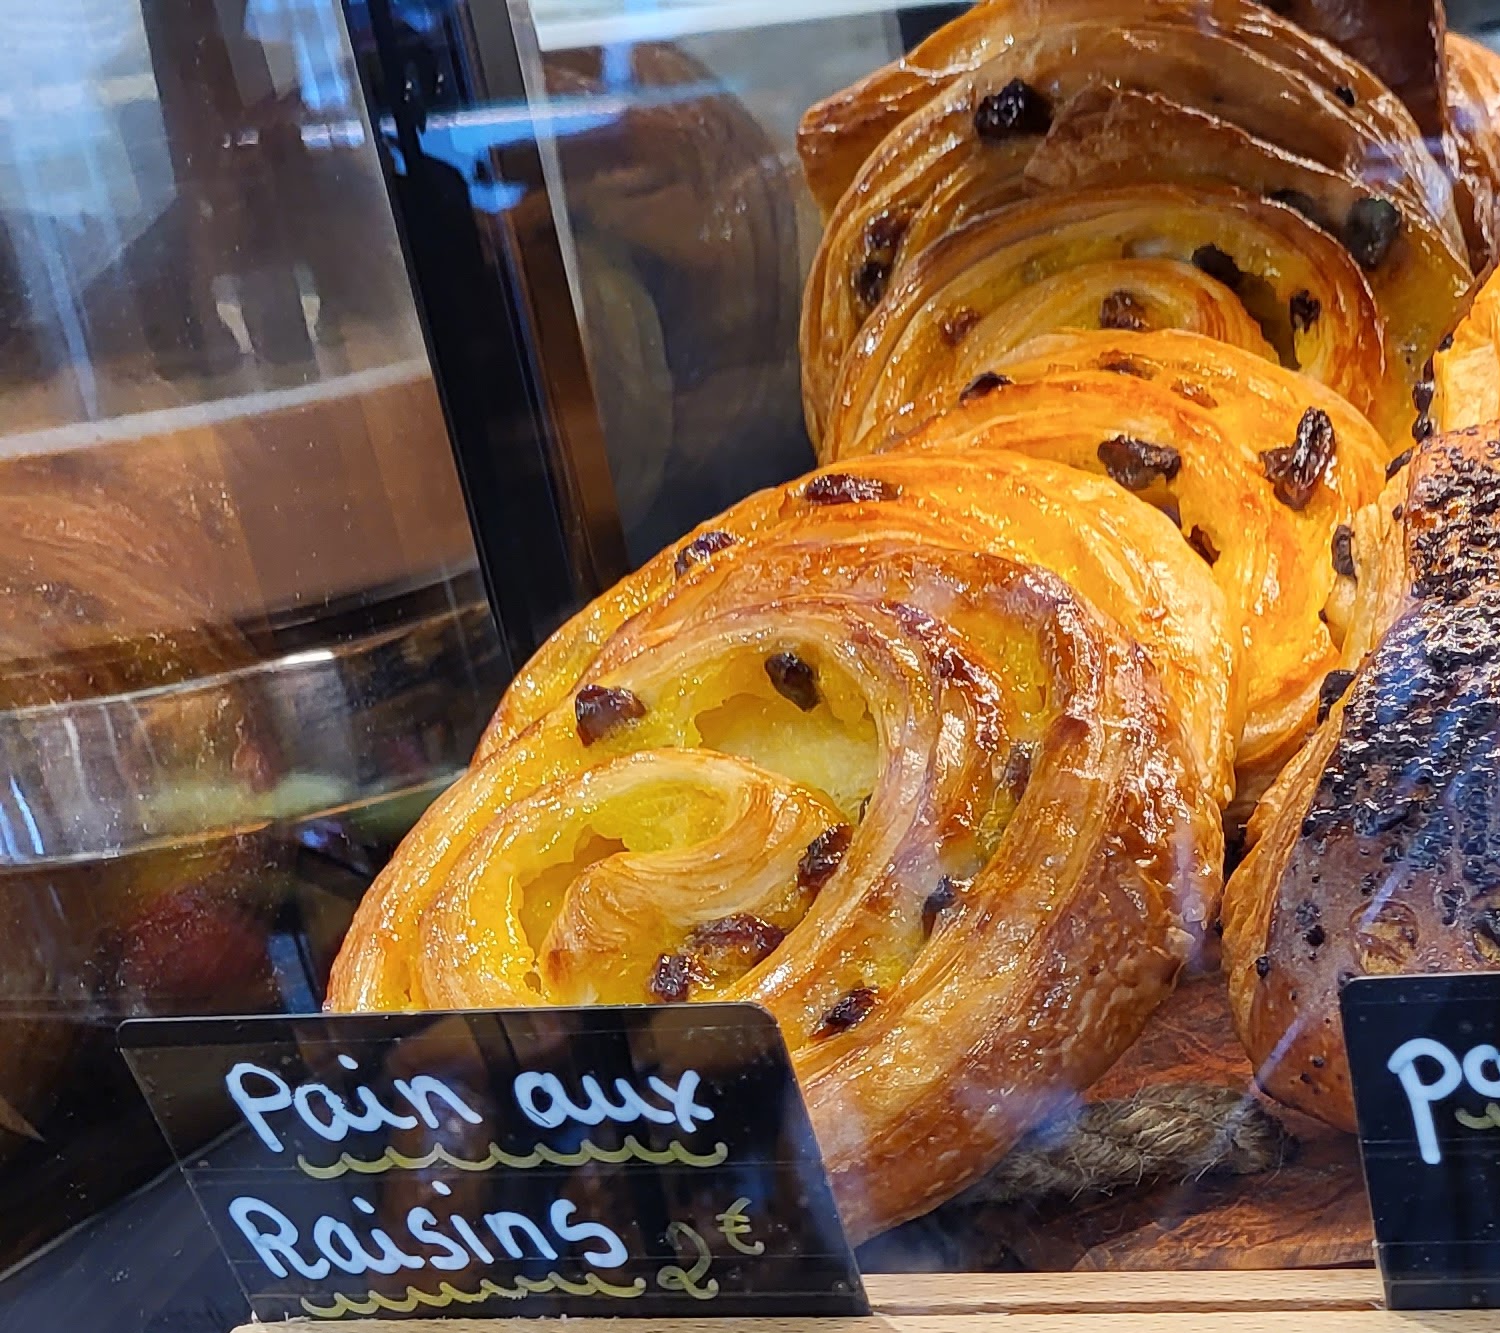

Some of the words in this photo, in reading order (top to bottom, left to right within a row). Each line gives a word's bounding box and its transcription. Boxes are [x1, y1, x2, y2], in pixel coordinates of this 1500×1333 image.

[225, 1053, 483, 1152] Pain
[514, 1069, 716, 1134] aux
[227, 1180, 630, 1281] Raisins
